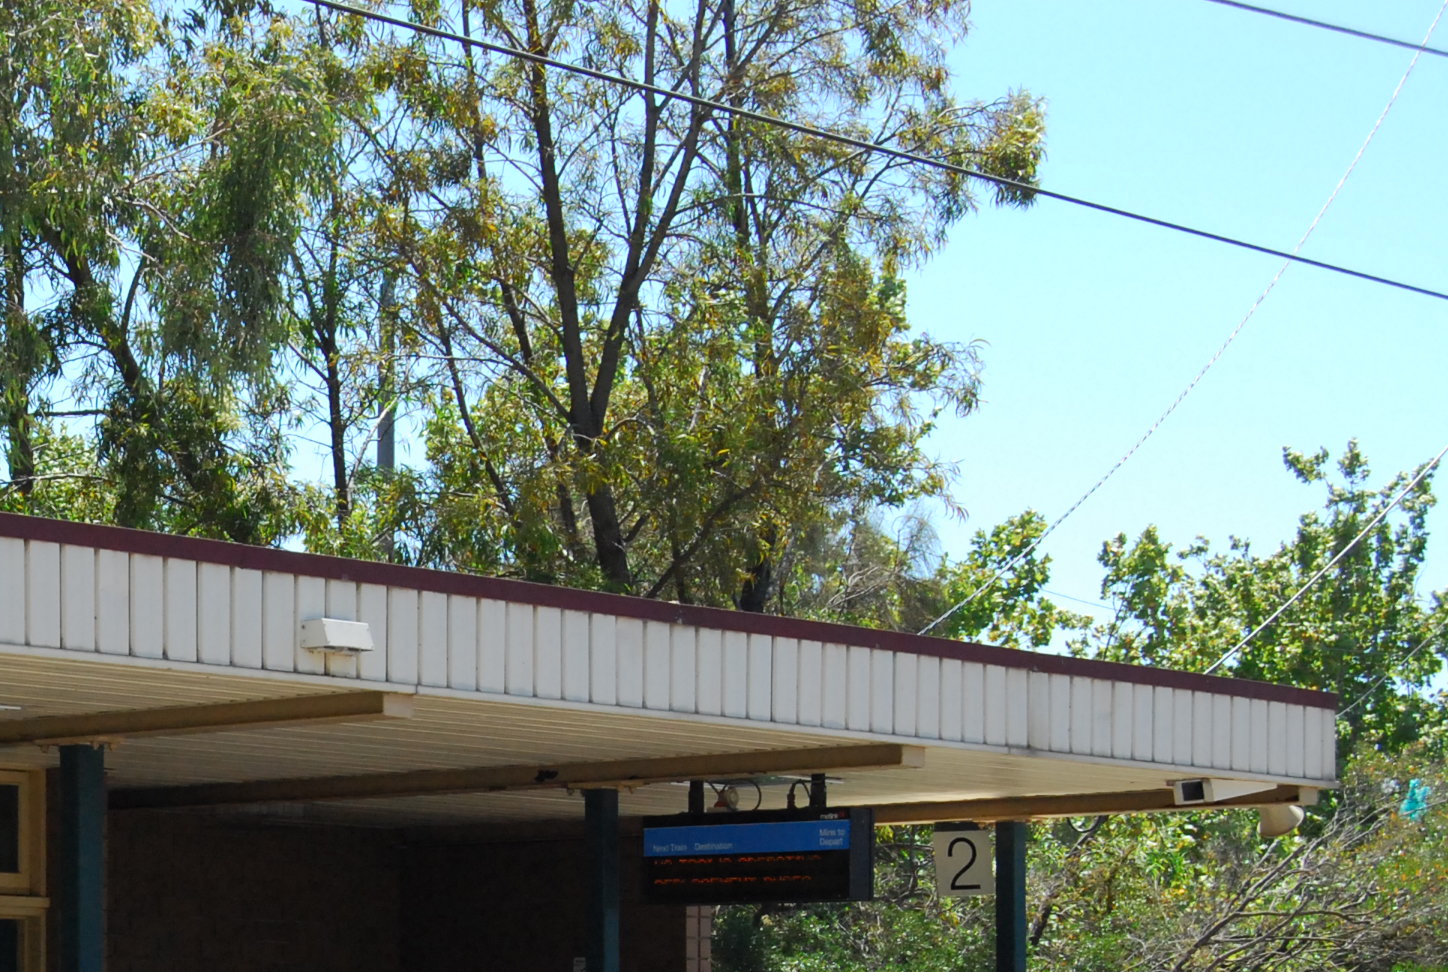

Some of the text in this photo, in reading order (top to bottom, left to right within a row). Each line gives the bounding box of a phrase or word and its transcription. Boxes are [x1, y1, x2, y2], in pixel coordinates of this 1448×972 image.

[819, 829, 836, 837] Mins
[652, 842, 733, 853] Next Train Destination
[819, 838, 844, 847] Depart
[948, 836, 981, 891] 2
